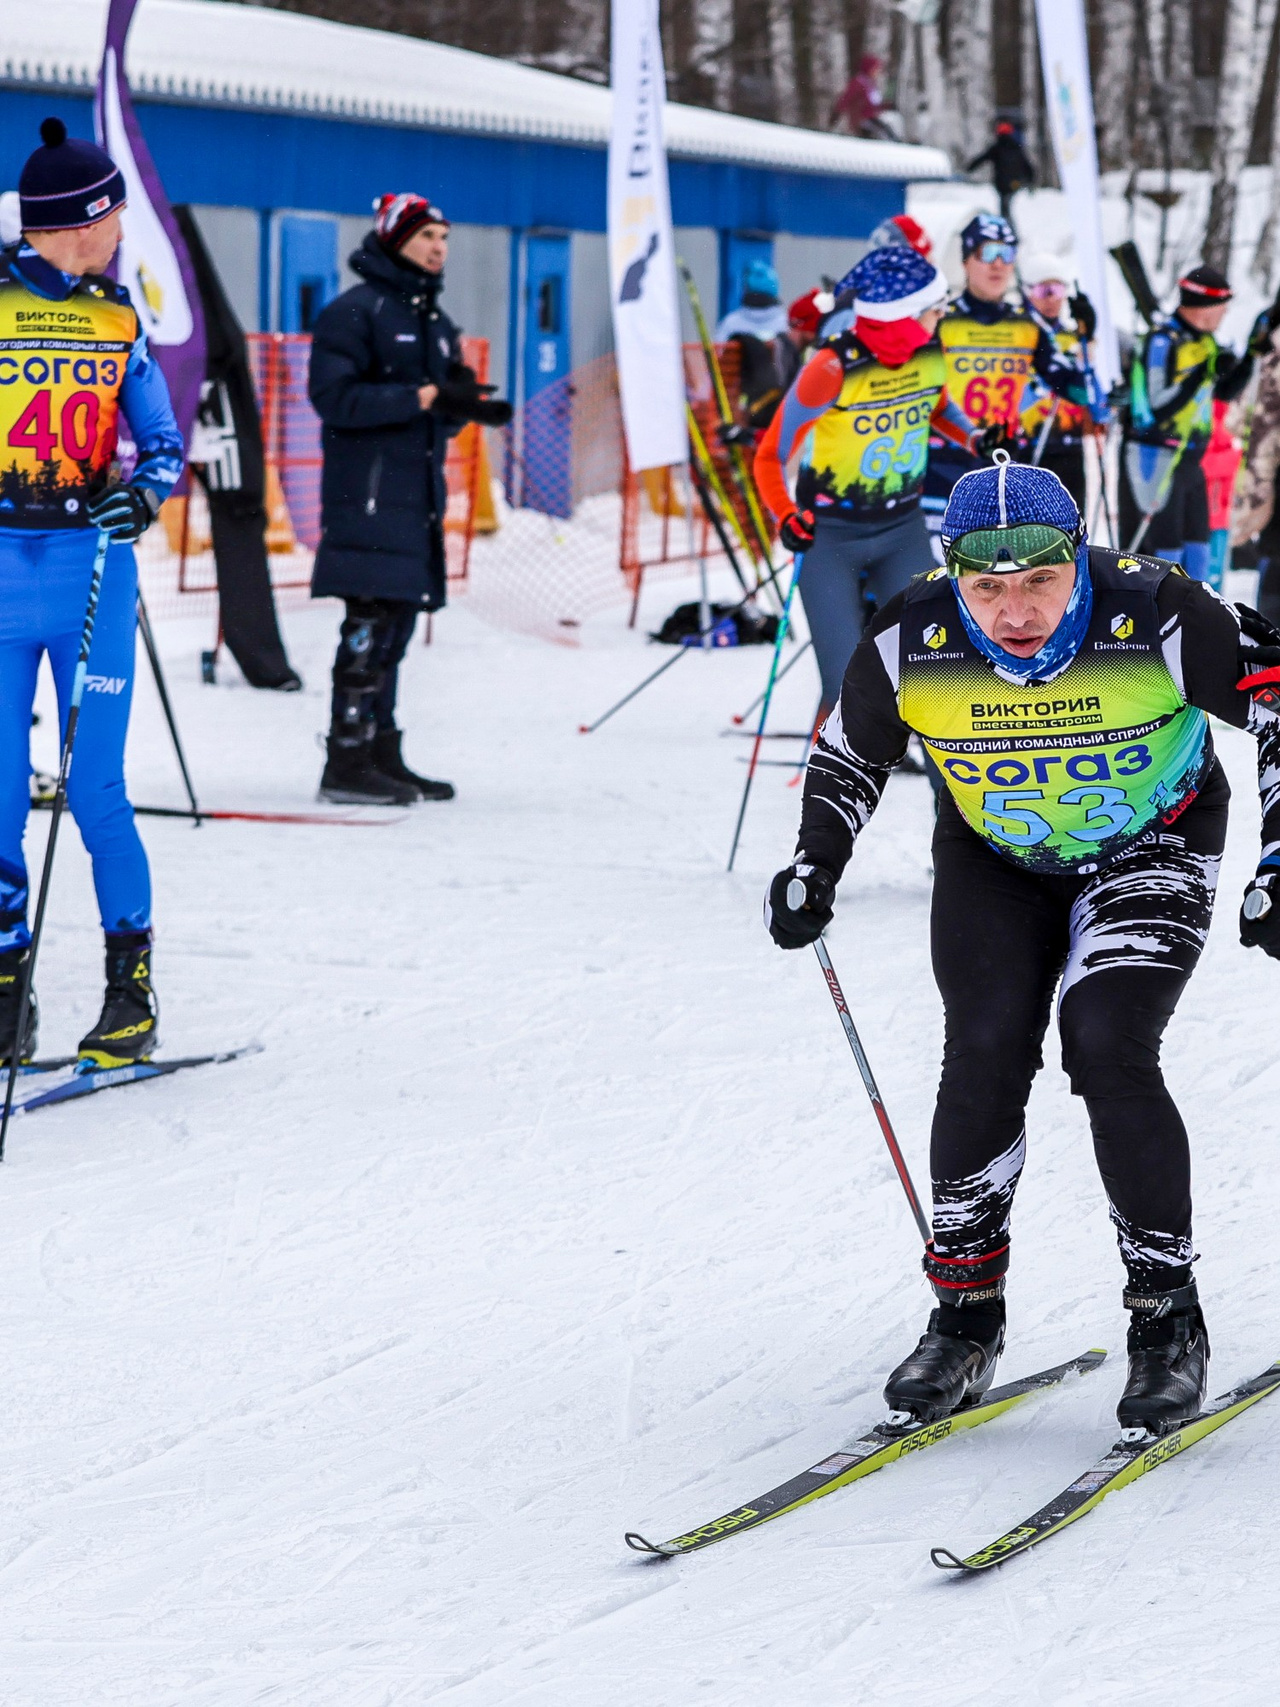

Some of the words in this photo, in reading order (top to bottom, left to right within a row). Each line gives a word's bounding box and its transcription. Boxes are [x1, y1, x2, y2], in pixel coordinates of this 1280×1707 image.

[964, 376, 1015, 418] 63
[8, 390, 99, 461] 40
[860, 427, 927, 479] 65
[971, 697, 1101, 717] ВИКТОРИЯ
[973, 720, 1023, 731] вместе
[1027, 719, 1047, 728] мы
[1050, 714, 1101, 727] строим
[1015, 733, 1105, 748] КОМАНДНЫЙ
[1108, 720, 1162, 742] СПРИНТ
[981, 786, 1136, 847] 53
[1111, 830, 1156, 863] DIWARI
[899, 1420, 953, 1457] FISCHER
[1143, 1434, 1182, 1472] FISCHER
[668, 1507, 760, 1548] FISCHE
